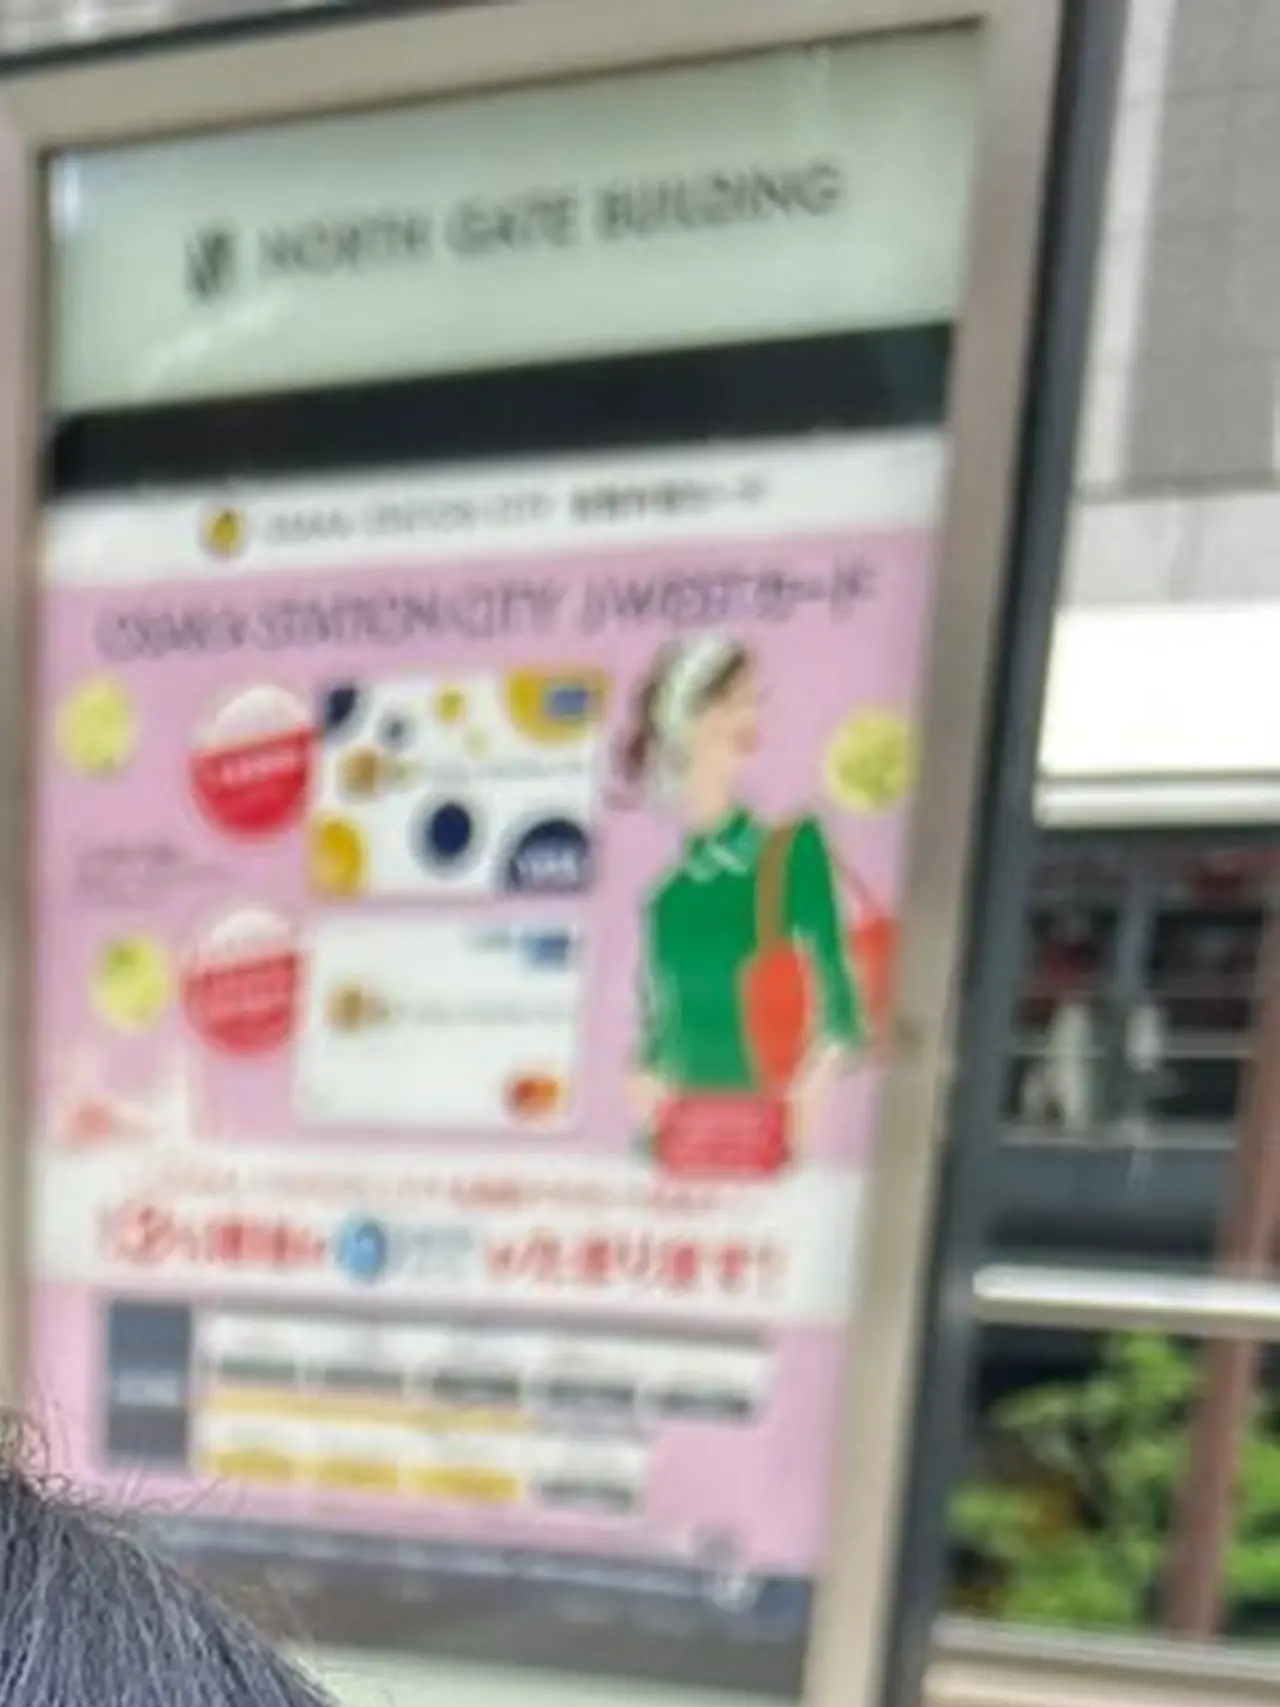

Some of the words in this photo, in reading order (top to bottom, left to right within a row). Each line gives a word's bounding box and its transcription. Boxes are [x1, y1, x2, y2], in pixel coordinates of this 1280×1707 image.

[256, 214, 433, 278] NORTH
[443, 188, 579, 260] GATE
[591, 160, 844, 246] BUILDING
